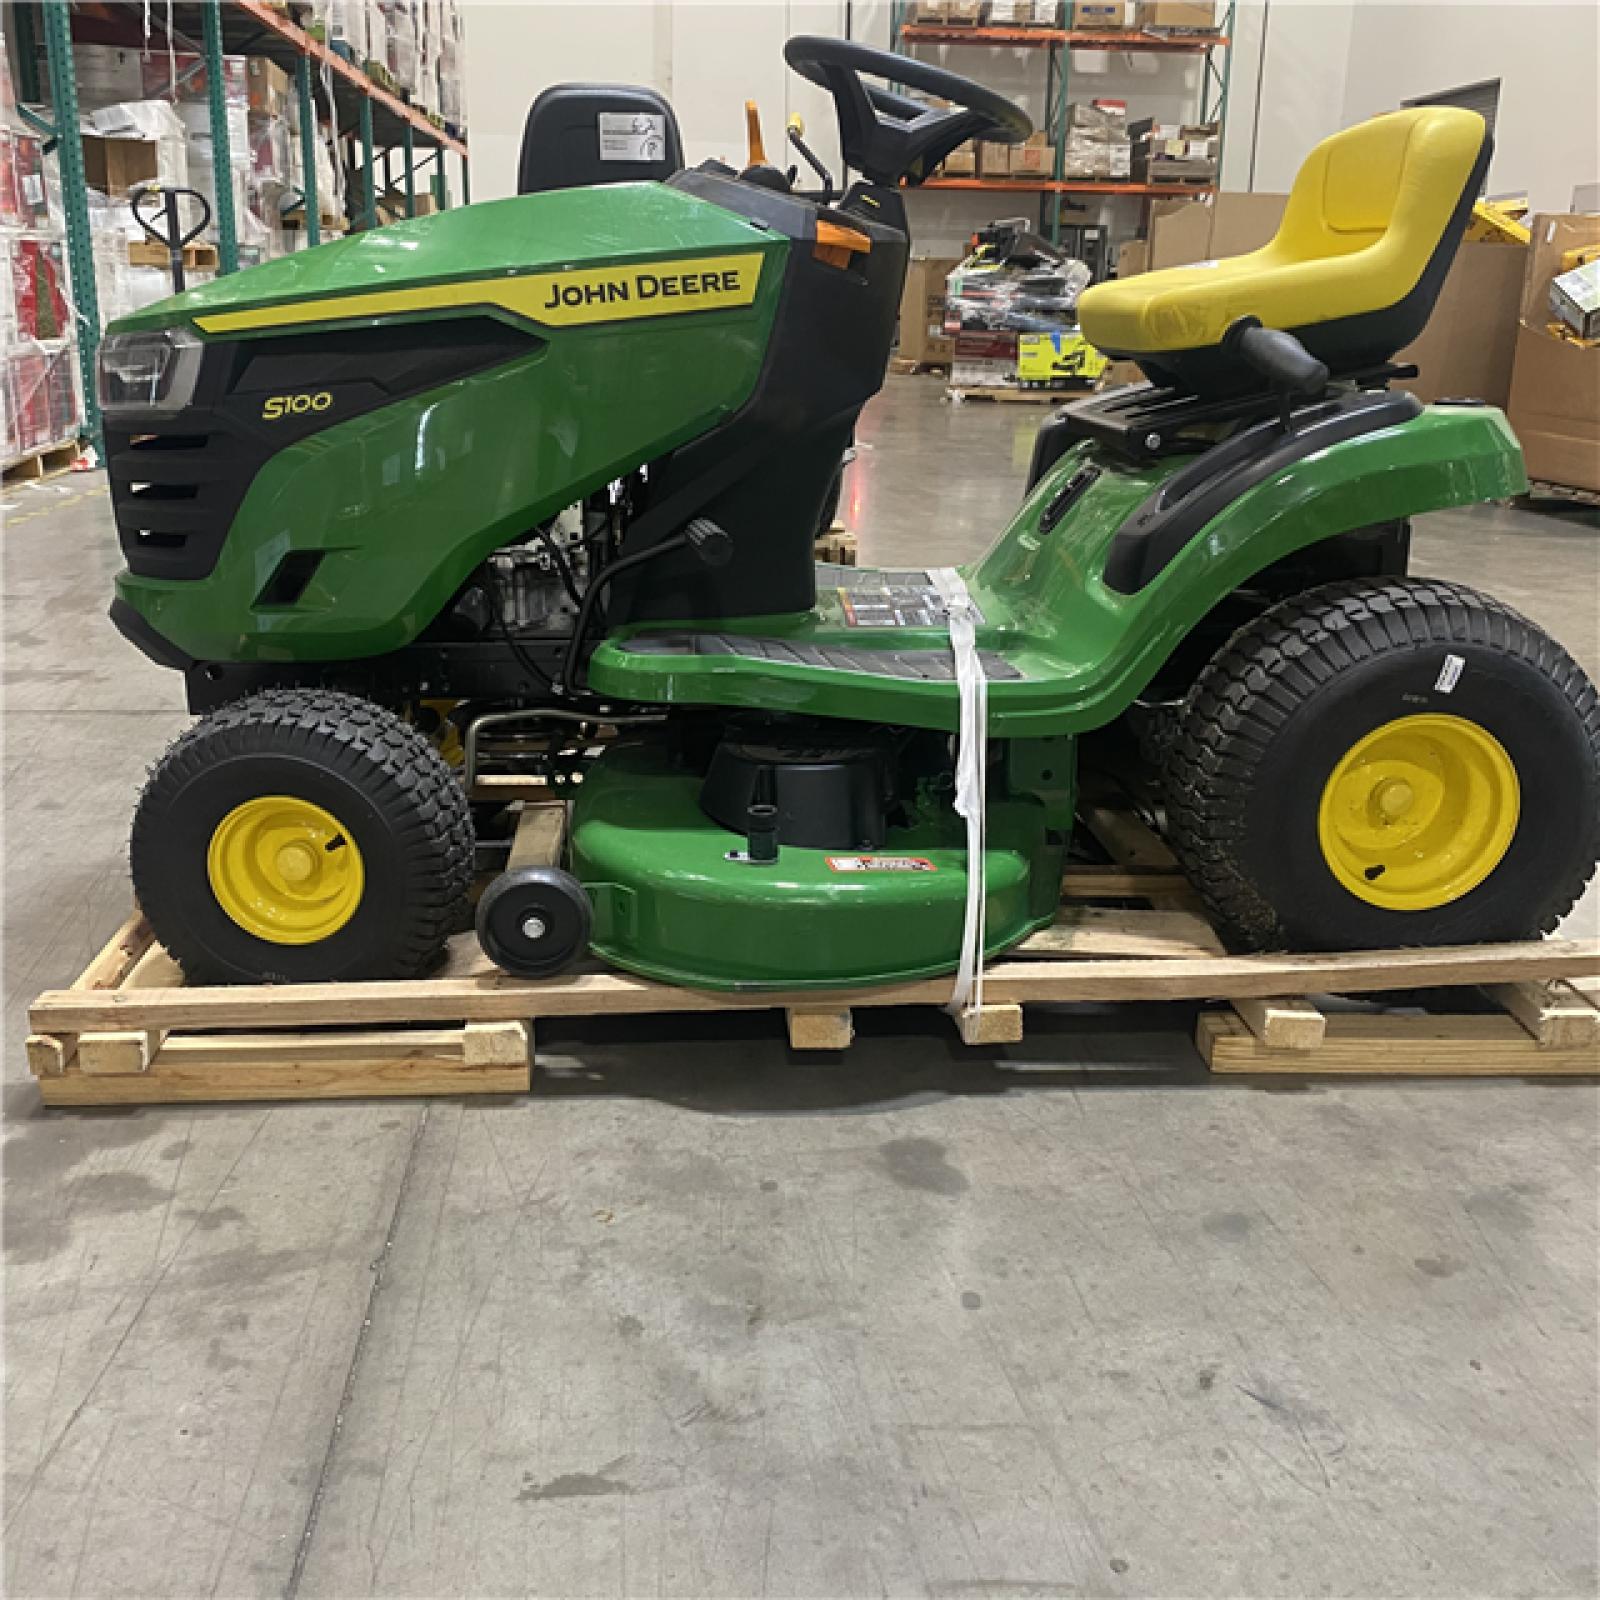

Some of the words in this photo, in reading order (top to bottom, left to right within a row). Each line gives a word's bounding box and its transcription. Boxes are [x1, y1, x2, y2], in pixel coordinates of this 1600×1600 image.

[544, 281, 629, 309] JOHN
[635, 270, 741, 298] DEERE
[262, 392, 332, 420] S100
